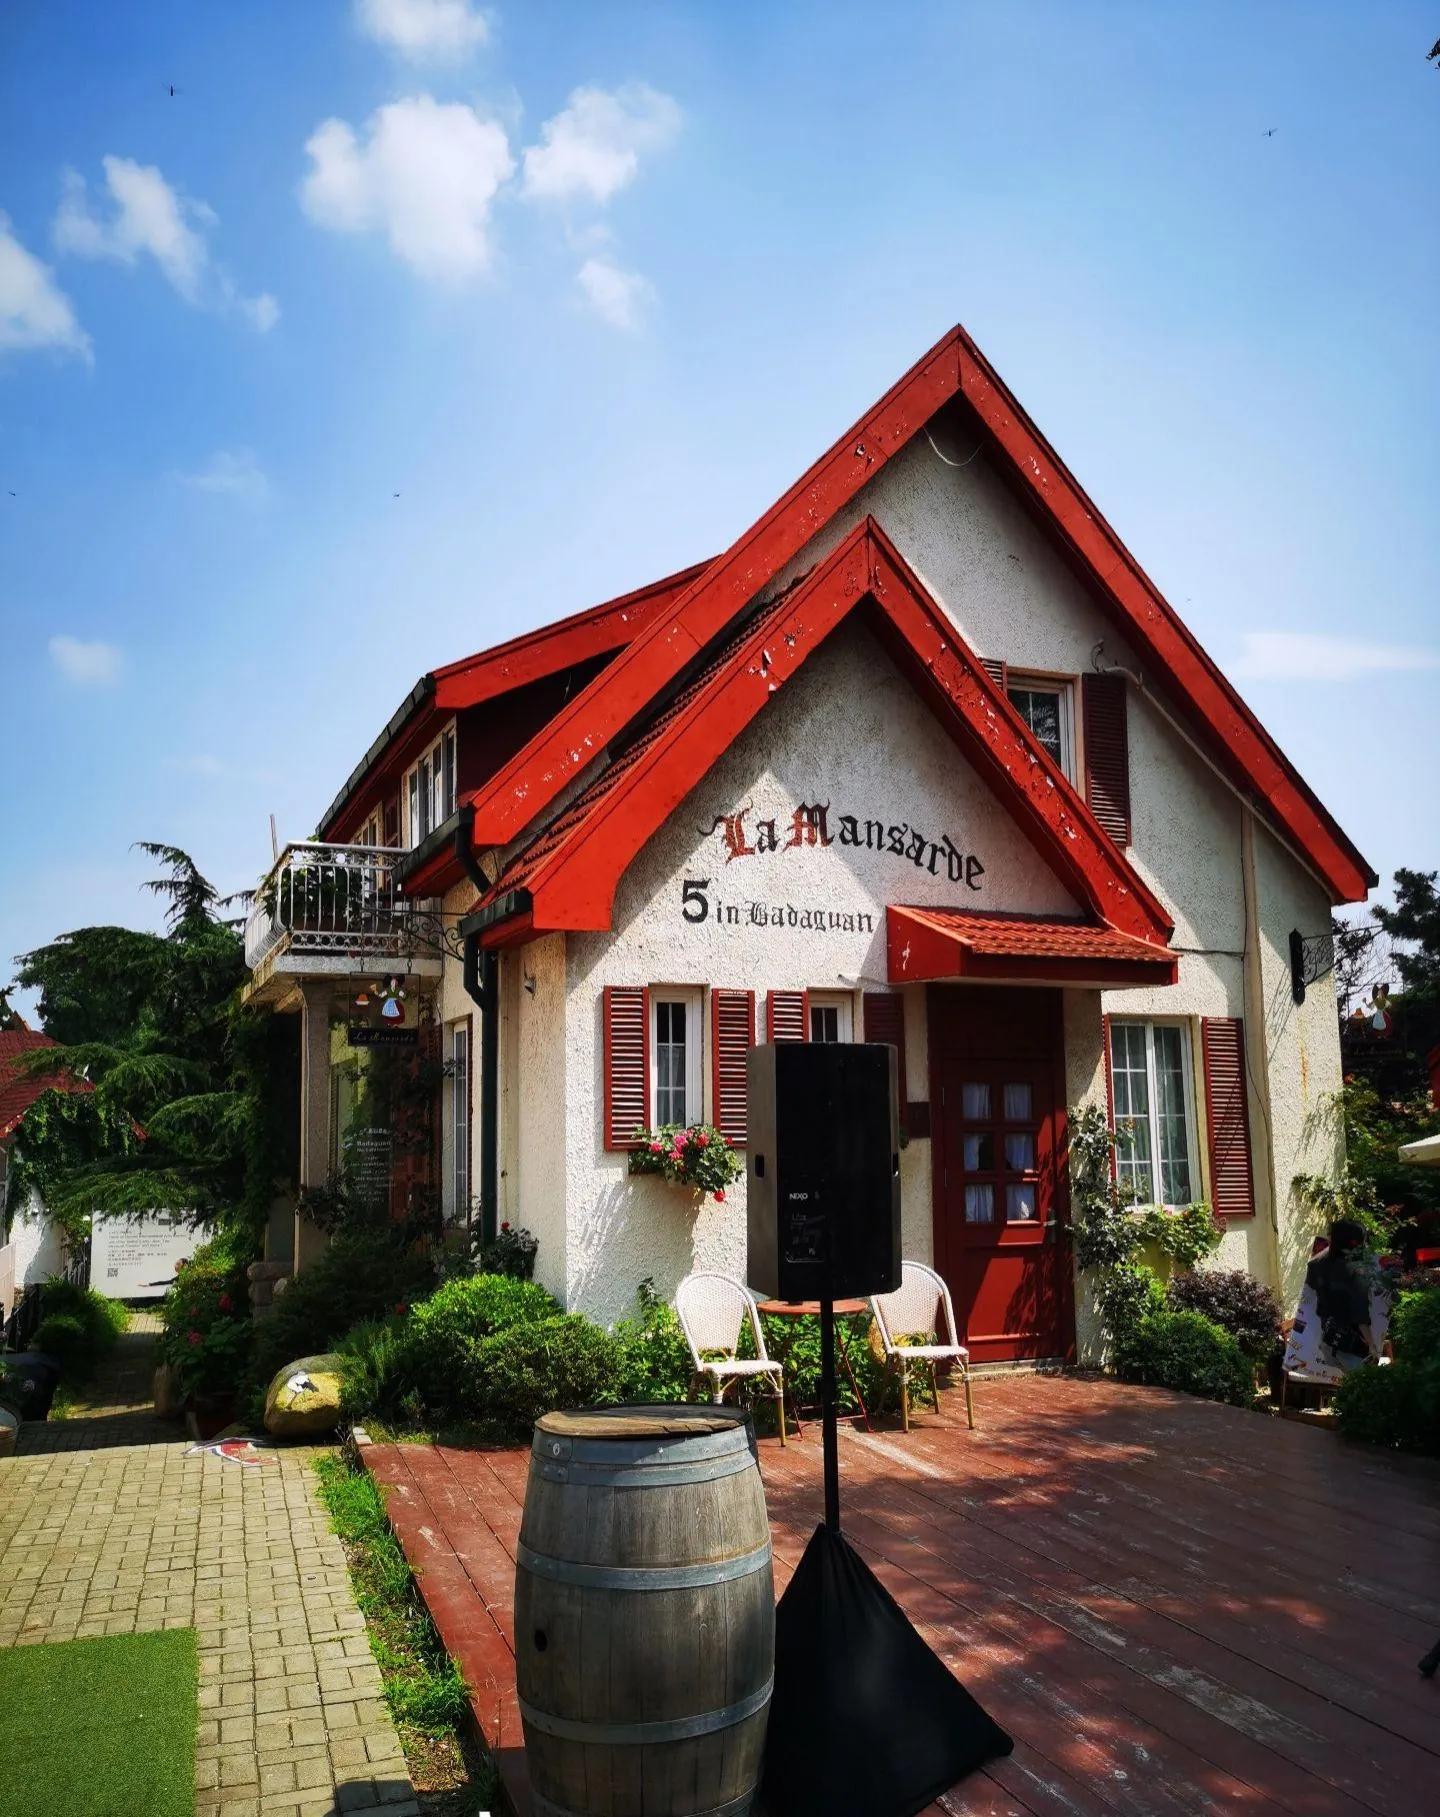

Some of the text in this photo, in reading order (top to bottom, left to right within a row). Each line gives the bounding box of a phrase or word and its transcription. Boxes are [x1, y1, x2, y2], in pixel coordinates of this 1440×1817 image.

[697, 797, 985, 891] La Mansarde
[682, 879, 875, 933] 5 in Badaguan
